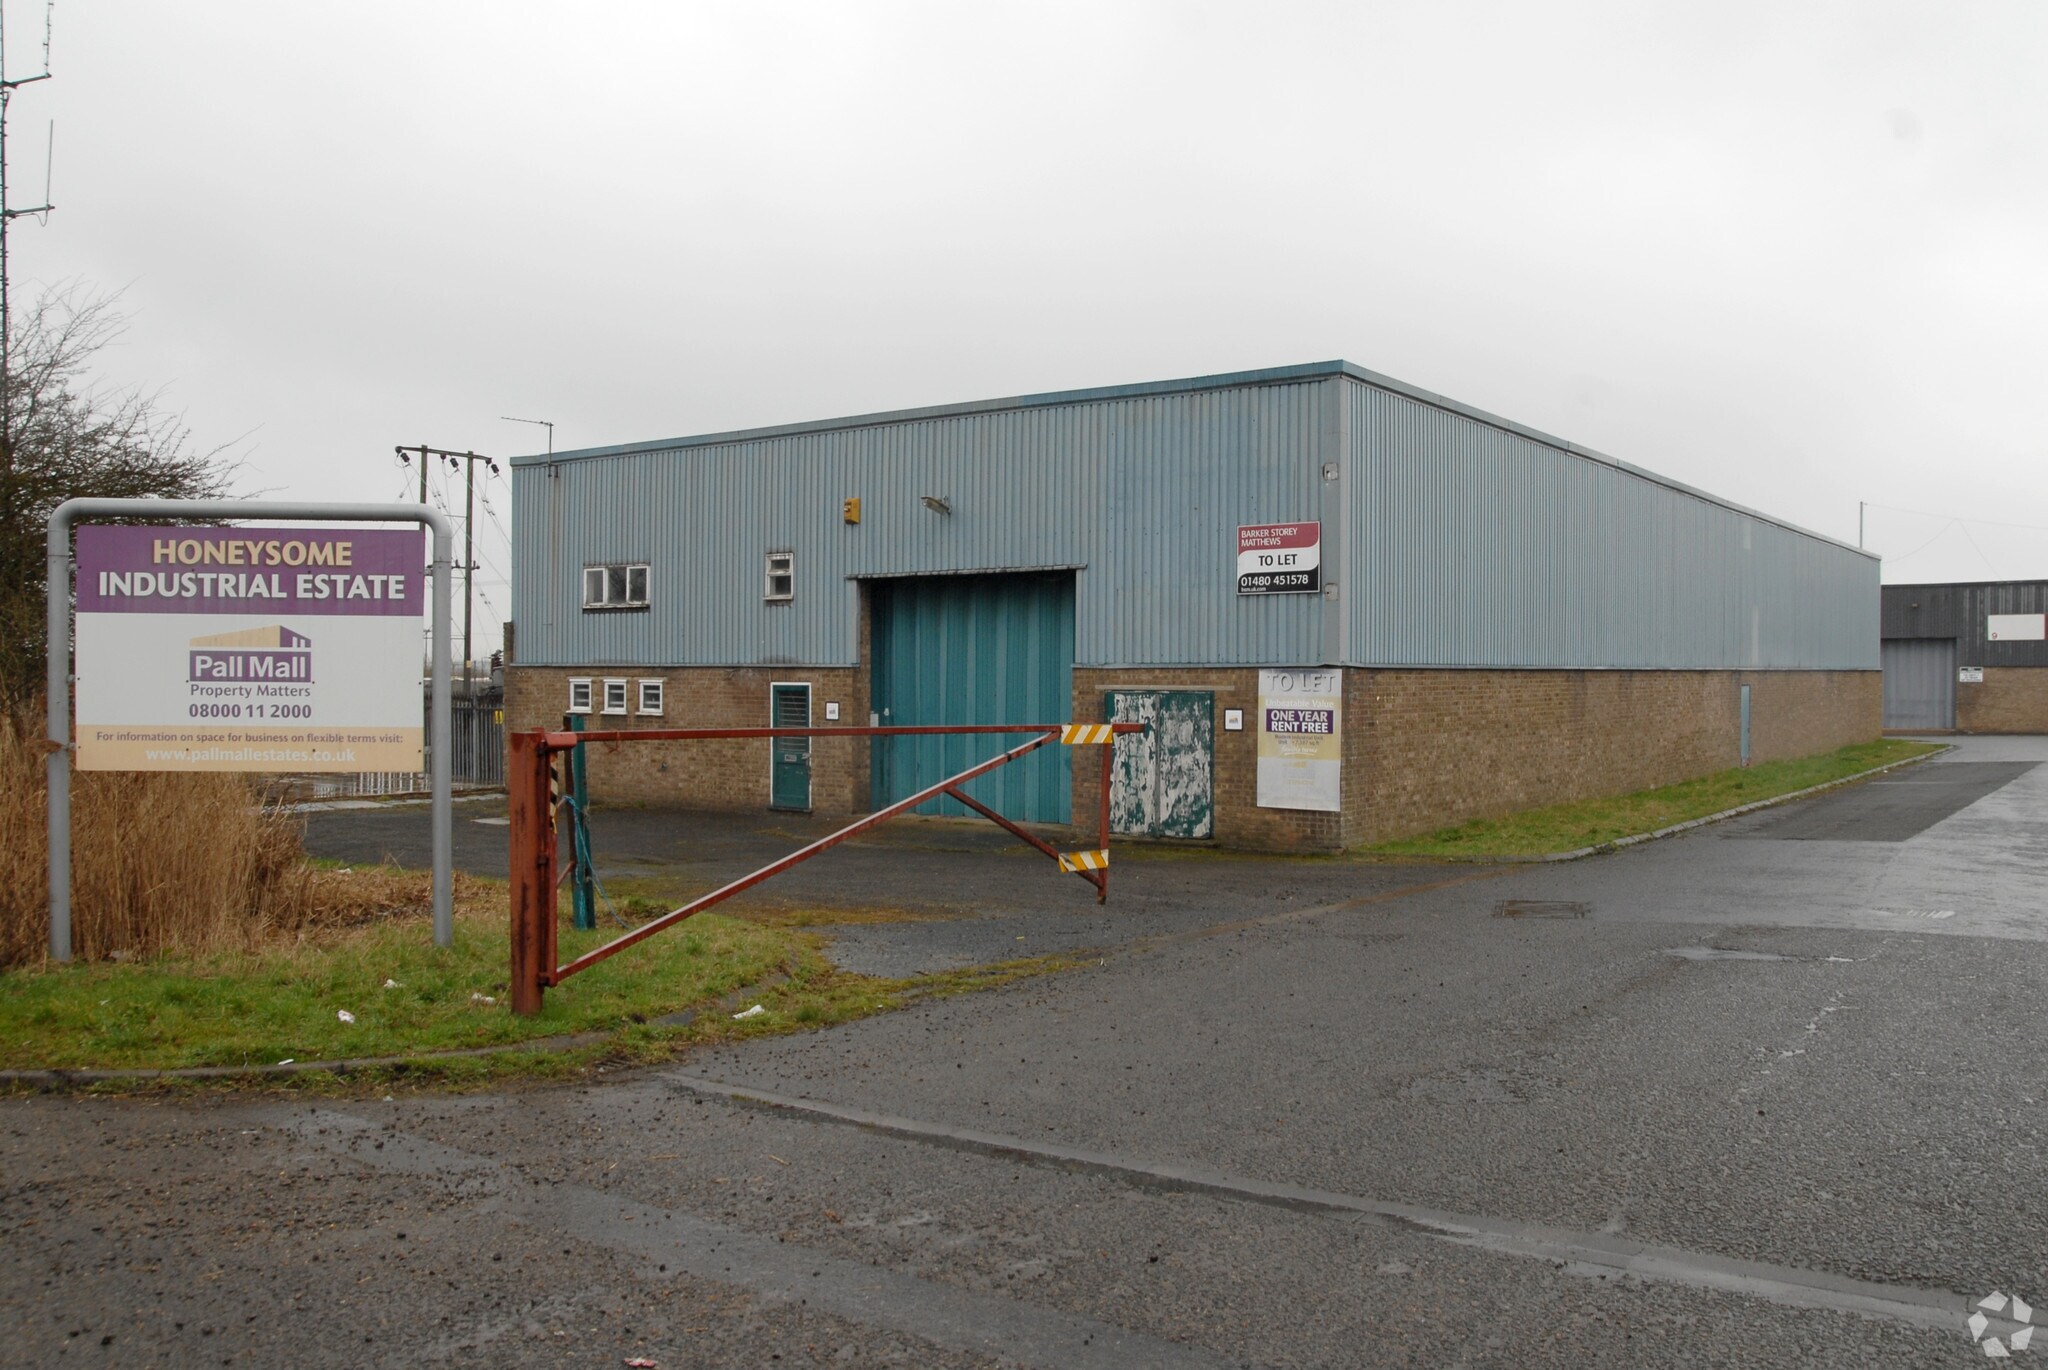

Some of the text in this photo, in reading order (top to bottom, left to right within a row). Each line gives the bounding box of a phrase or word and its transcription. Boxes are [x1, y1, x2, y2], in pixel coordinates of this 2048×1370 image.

[1241, 528, 1297, 538] BARKER STOREY
[1241, 538, 1280, 546] MATTHEWS
[153, 539, 353, 567] HONEYSOME
[1258, 554, 1297, 566] TO LET
[99, 571, 406, 600] INDUSTRIAL ESTATE
[1241, 575, 1308, 586] 01480 451578
[195, 655, 306, 678] Pall Mall
[1267, 673, 1336, 693] TO LET
[190, 684, 311, 698] Property Matters
[189, 704, 312, 719] 08000 11 2000
[1271, 710, 1328, 722] ONE YEAR
[1271, 722, 1328, 733] RENT FREE
[96, 731, 404, 744] For information on space for business on flexible terms visit:
[145, 748, 356, 763] www.pallmallestates.co.uk
